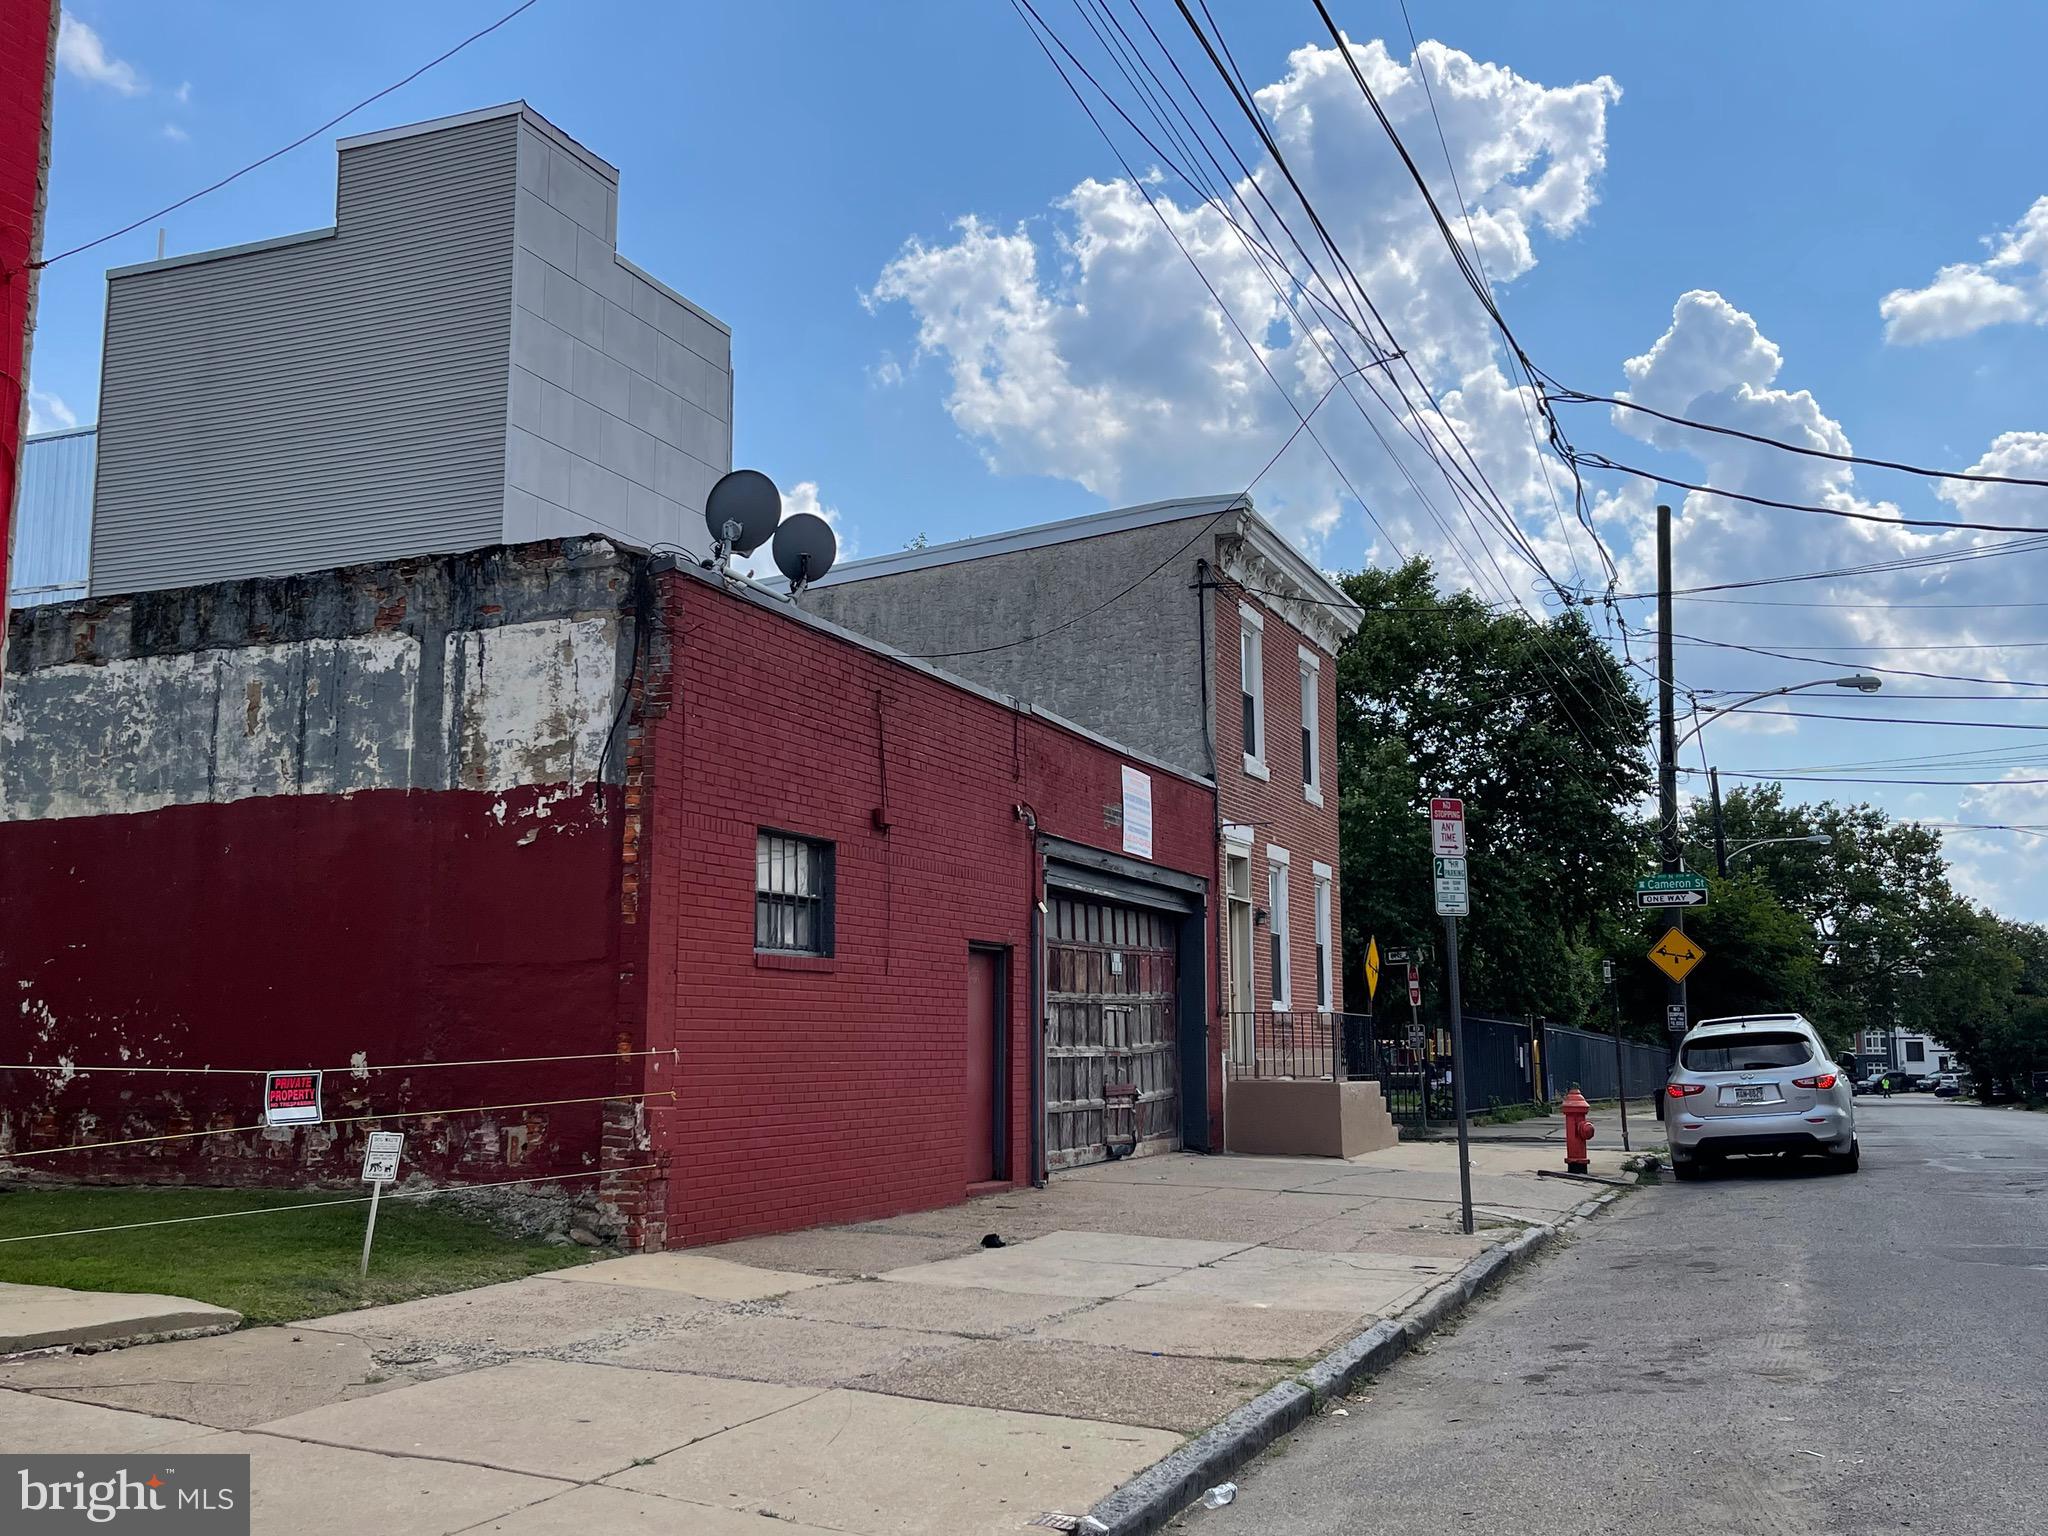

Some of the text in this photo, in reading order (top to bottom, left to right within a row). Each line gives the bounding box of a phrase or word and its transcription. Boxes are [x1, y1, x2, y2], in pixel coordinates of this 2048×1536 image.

[1442, 801, 1451, 809] NO
[1434, 809, 1461, 818] STOPPING
[1441, 822, 1455, 832] ANY
[1441, 832, 1457, 843] TIME
[1436, 861, 1443, 876] 2
[1444, 869, 1465, 877] PARKING
[1647, 878, 1705, 889] Cameron St
[1646, 894, 1687, 903] ONE WAY
[275, 1077, 312, 1089] PRIVATE
[270, 1088, 315, 1102] PROPERTY
